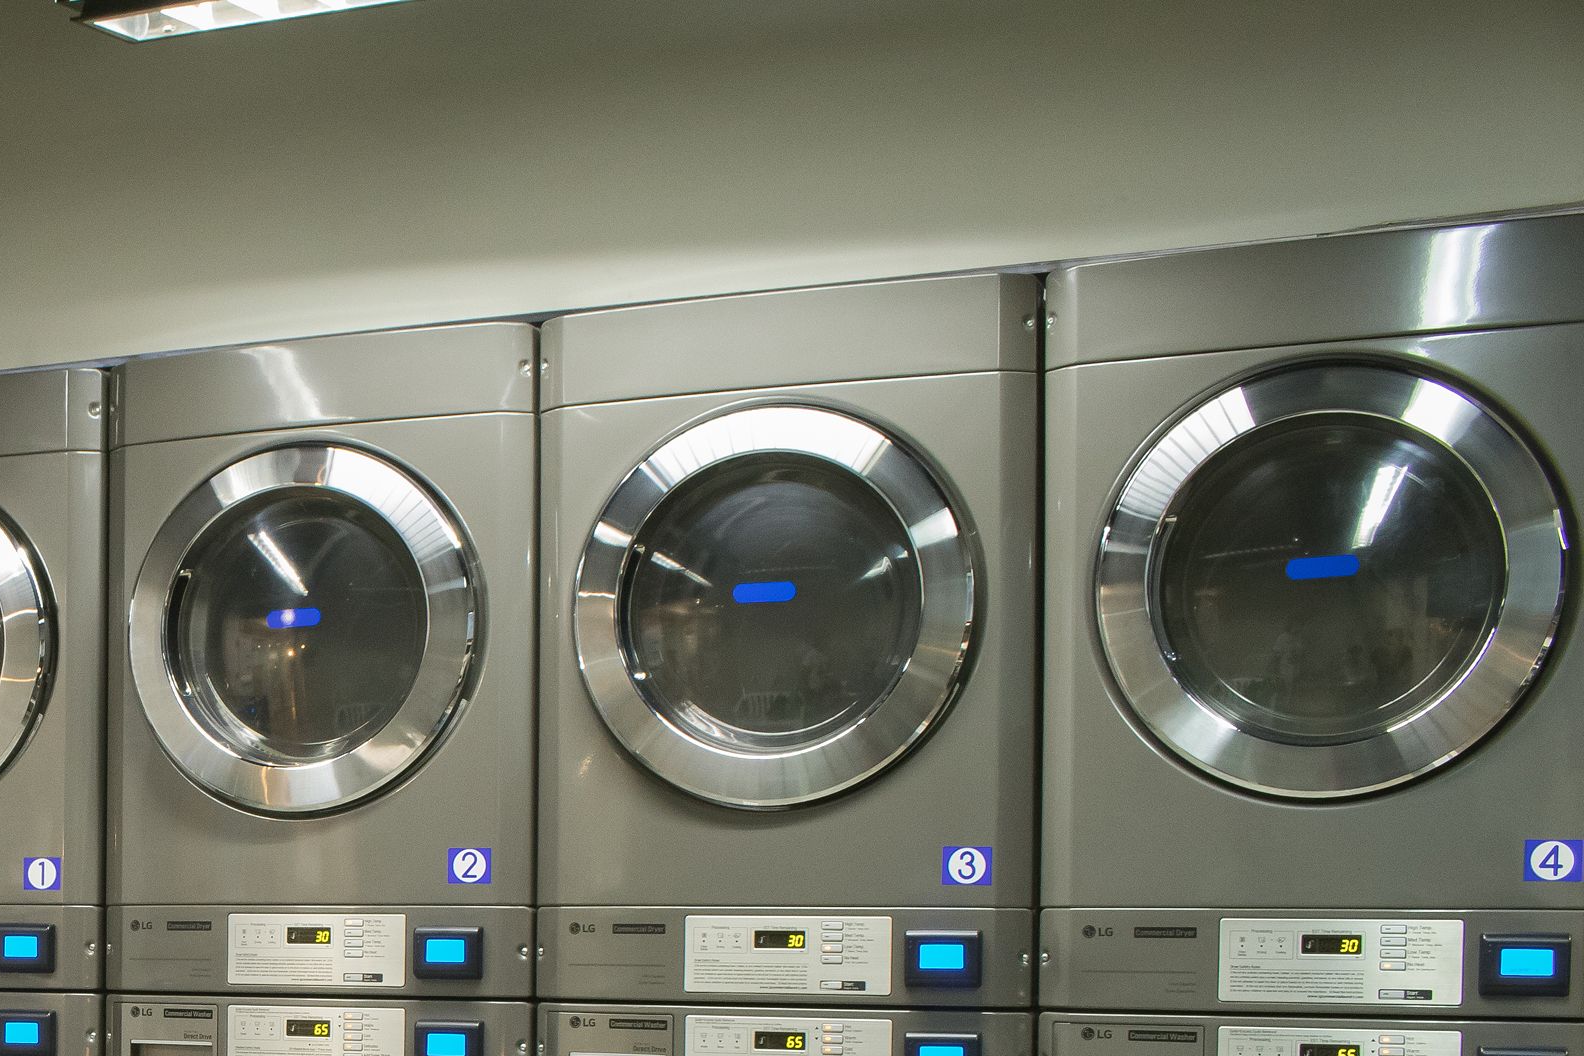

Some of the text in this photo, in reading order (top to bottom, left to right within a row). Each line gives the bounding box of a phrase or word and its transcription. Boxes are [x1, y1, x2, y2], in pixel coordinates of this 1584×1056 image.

[461, 851, 478, 879] 2
[957, 850, 977, 880] 3
[1538, 844, 1563, 876] 4
[38, 861, 45, 886] 1
[583, 924, 595, 932] LG
[1098, 928, 1113, 936] LG
[1177, 929, 1195, 937] Dryer
[316, 931, 330, 942] 30
[788, 934, 804, 947] 30
[1340, 939, 1359, 953] 30
[142, 1008, 152, 1016] LG
[583, 1019, 595, 1027] LG
[314, 1024, 329, 1035] 65
[1097, 1030, 1112, 1039] LG
[786, 1036, 803, 1049] 65
